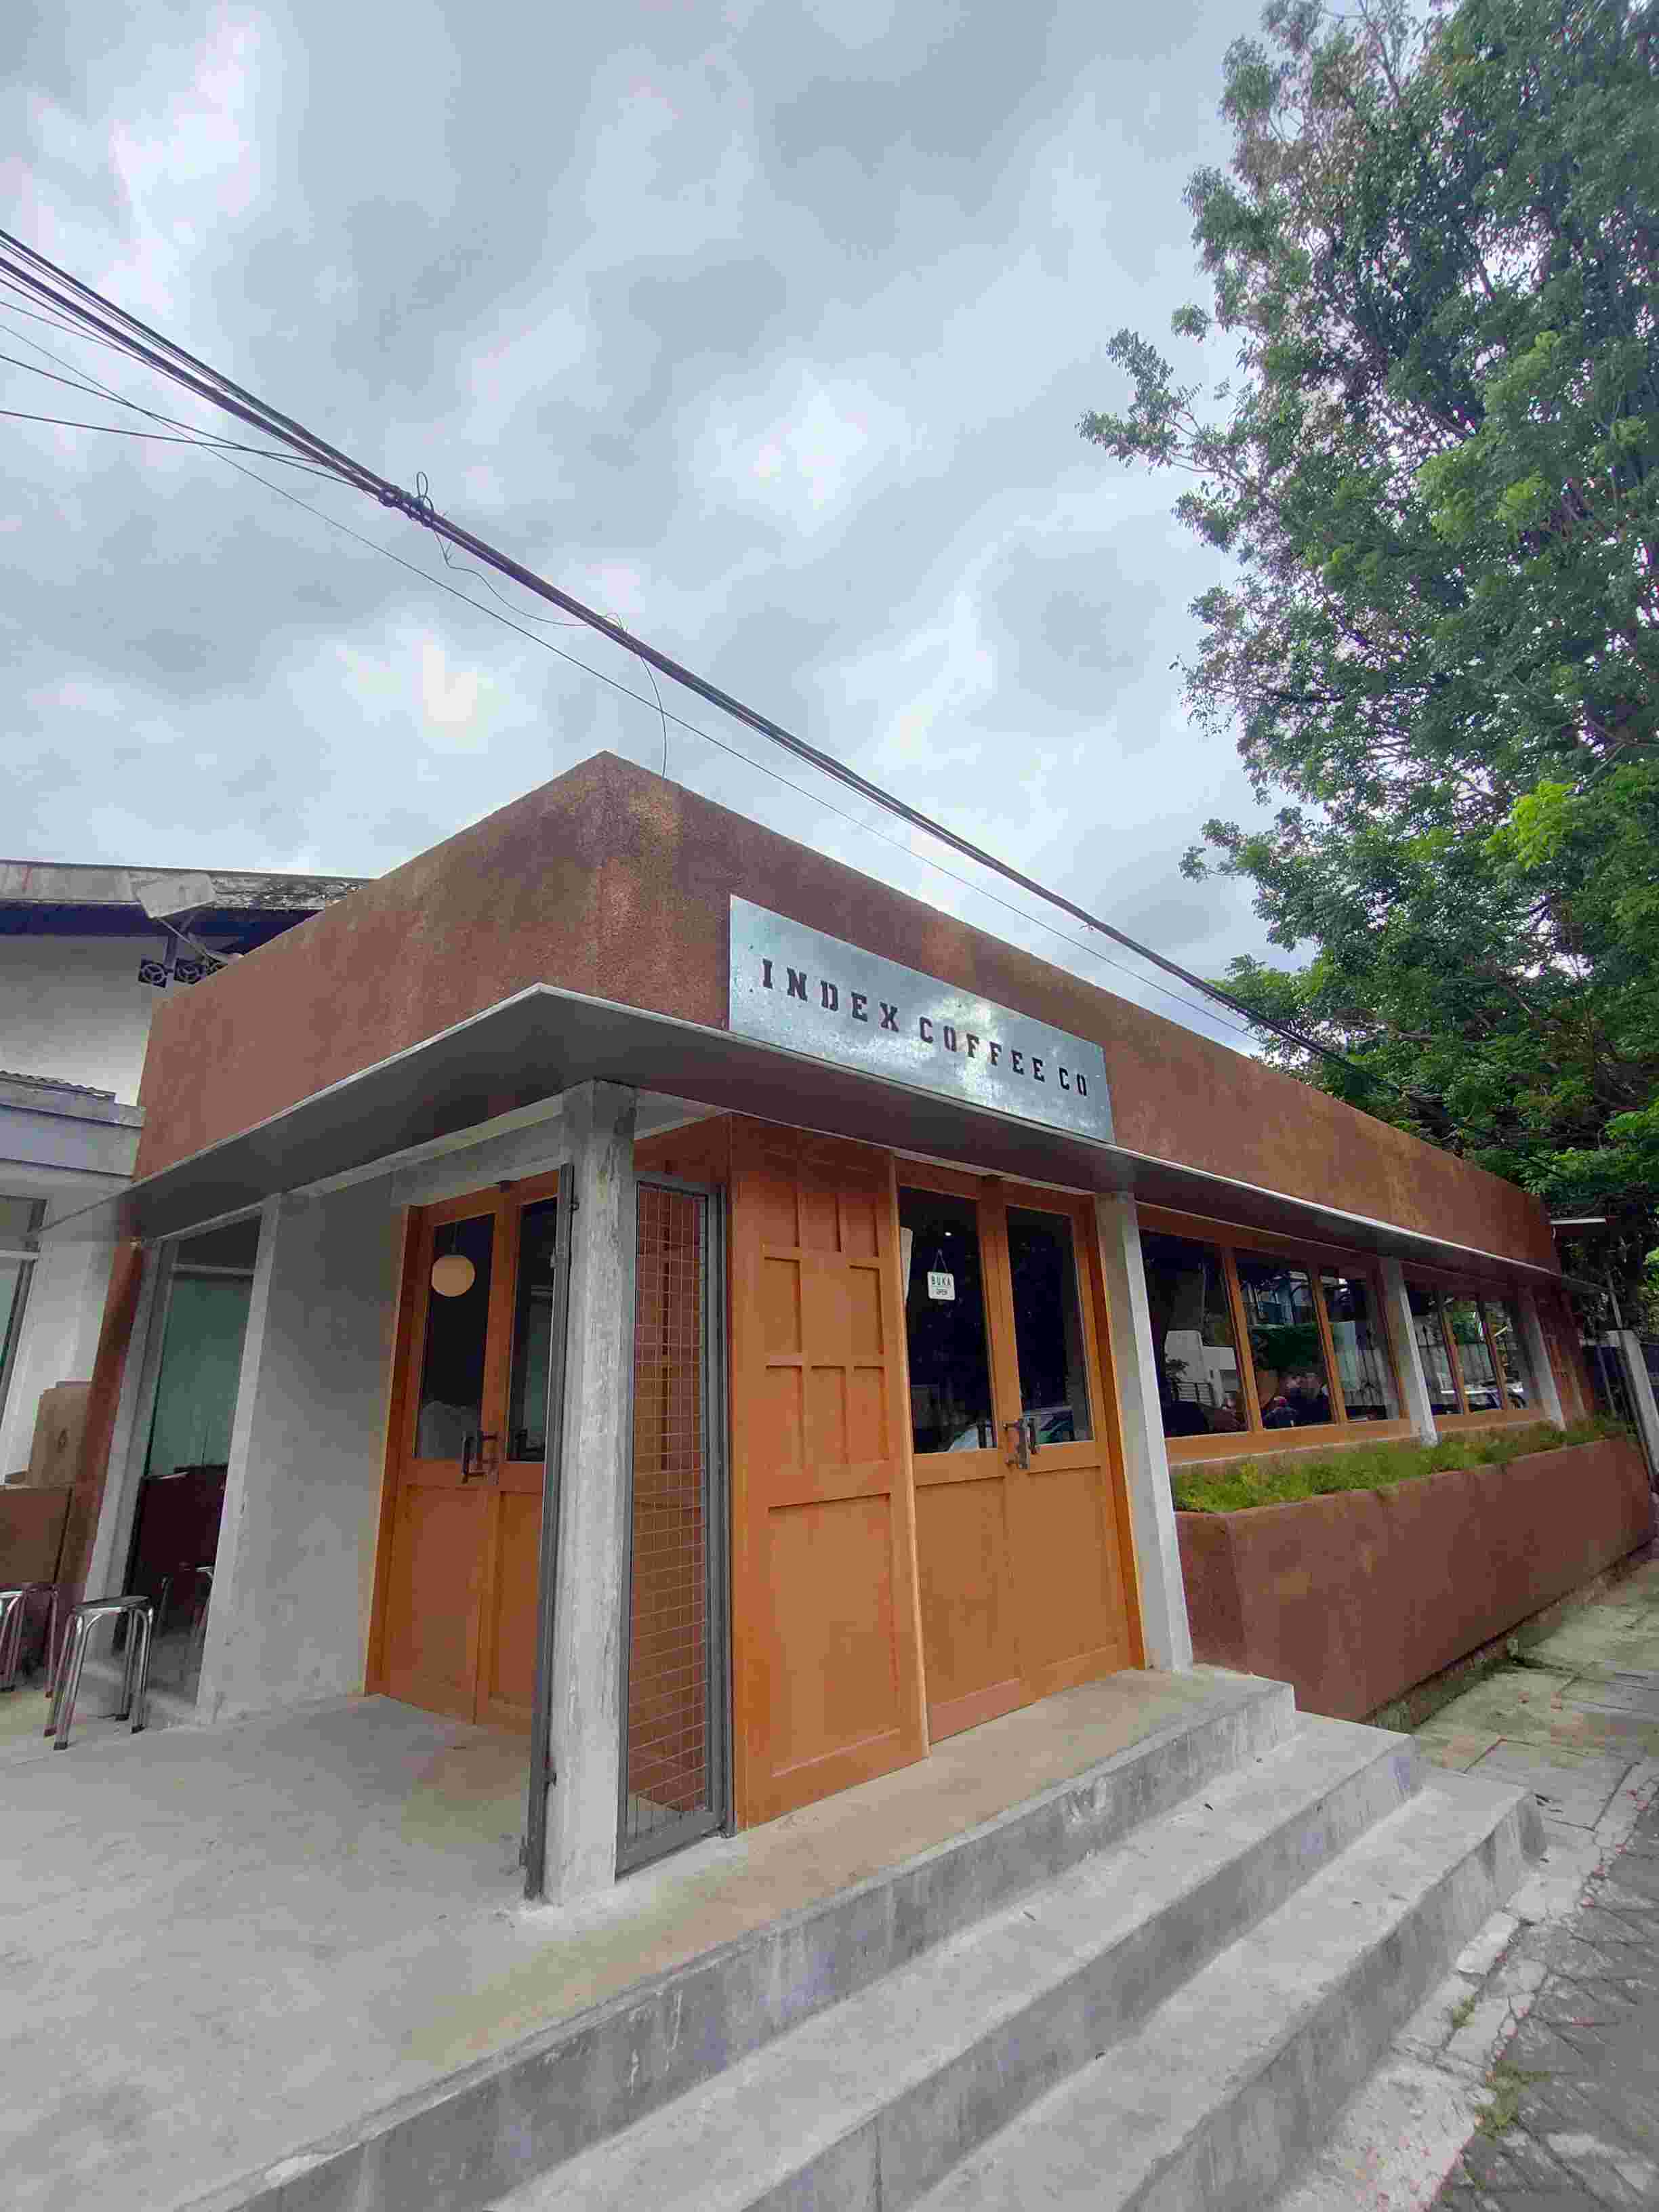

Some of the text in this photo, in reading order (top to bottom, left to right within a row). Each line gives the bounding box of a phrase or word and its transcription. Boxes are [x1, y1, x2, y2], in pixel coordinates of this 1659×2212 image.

[762, 959, 1088, 1097] INDEX COFFEE CO
[932, 1275, 951, 1286] BUKA
